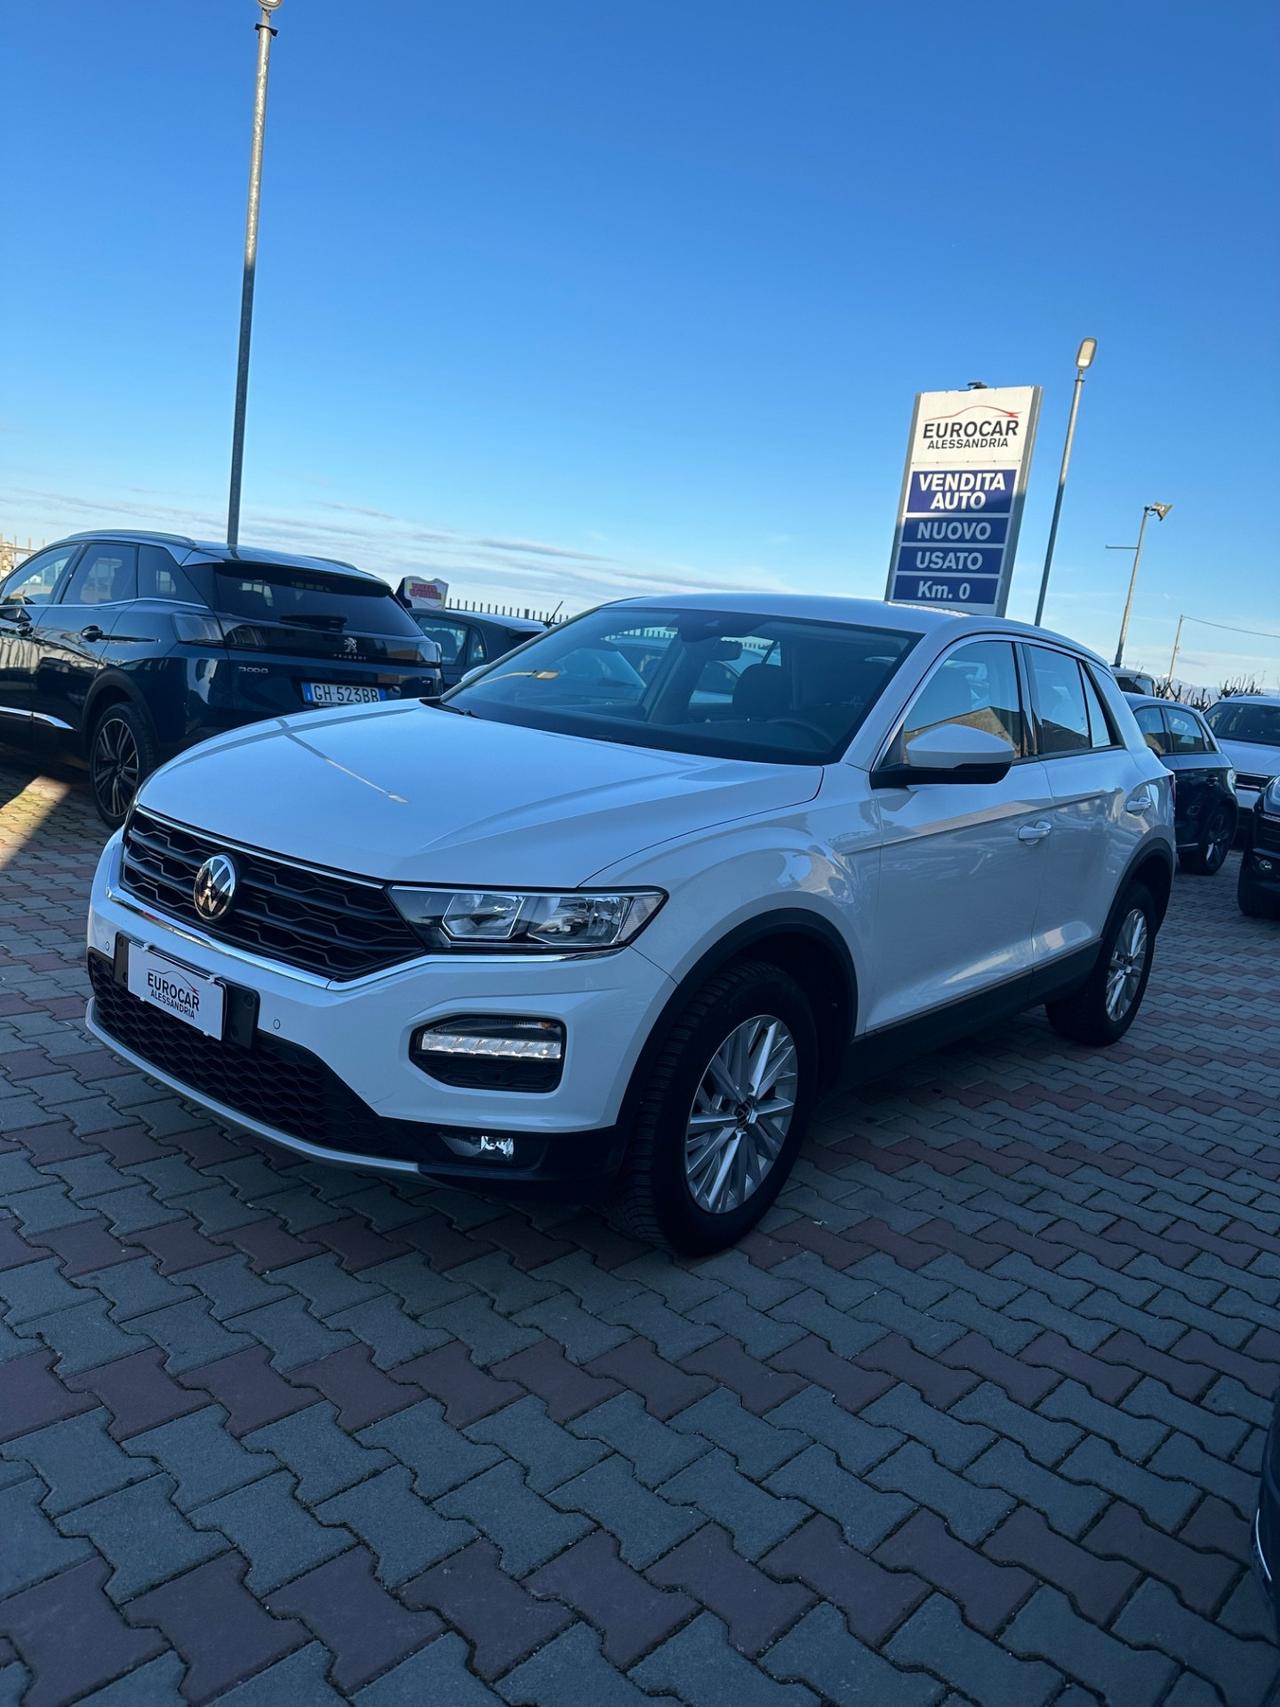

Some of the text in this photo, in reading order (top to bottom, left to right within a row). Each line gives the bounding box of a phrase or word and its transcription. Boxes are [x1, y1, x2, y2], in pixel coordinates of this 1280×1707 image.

[923, 420, 1019, 439] EUROCAR
[927, 437, 1009, 450] ALESSANDRIA
[919, 472, 1006, 491] VENDITA
[930, 491, 986, 510] AUTO
[917, 522, 991, 539] NUOVO
[916, 551, 983, 570] USATO
[917, 580, 971, 600] Km. 0
[313, 684, 333, 701] GH
[147, 971, 200, 1010] EUROCAR
[150, 988, 196, 1019] ALESSANDRIA
